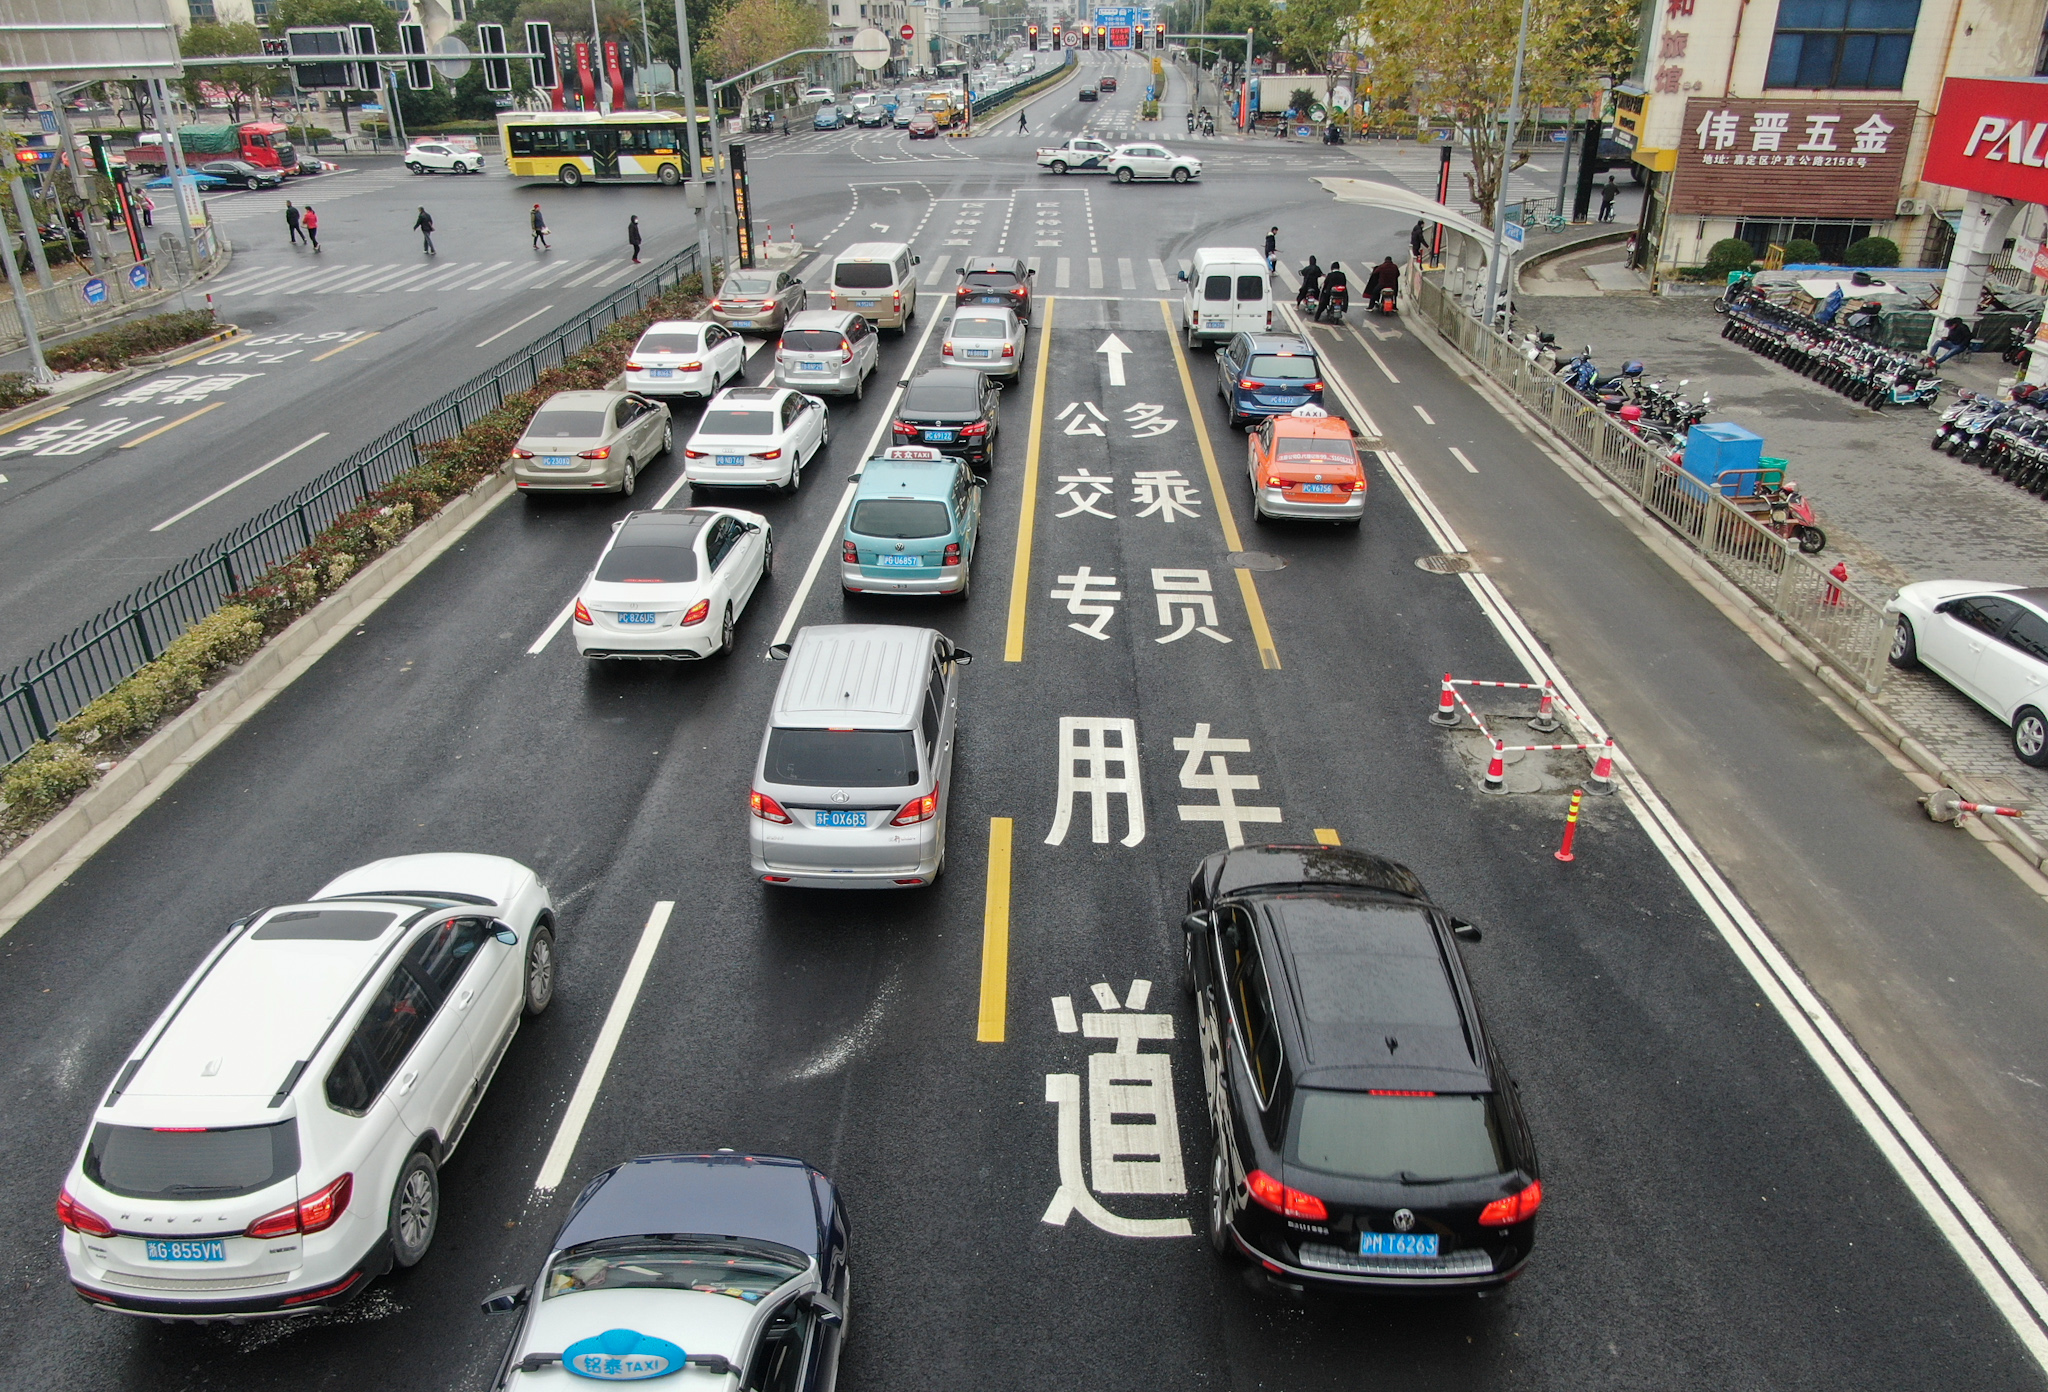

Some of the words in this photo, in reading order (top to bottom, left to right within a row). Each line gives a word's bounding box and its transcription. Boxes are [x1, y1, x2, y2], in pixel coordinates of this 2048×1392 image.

[1066, 34, 1075, 43] 60
[1696, 109, 1895, 154] 伟晋五金
[1963, 115, 2048, 169] PAL
[1299, 410, 1322, 418] TAXI
